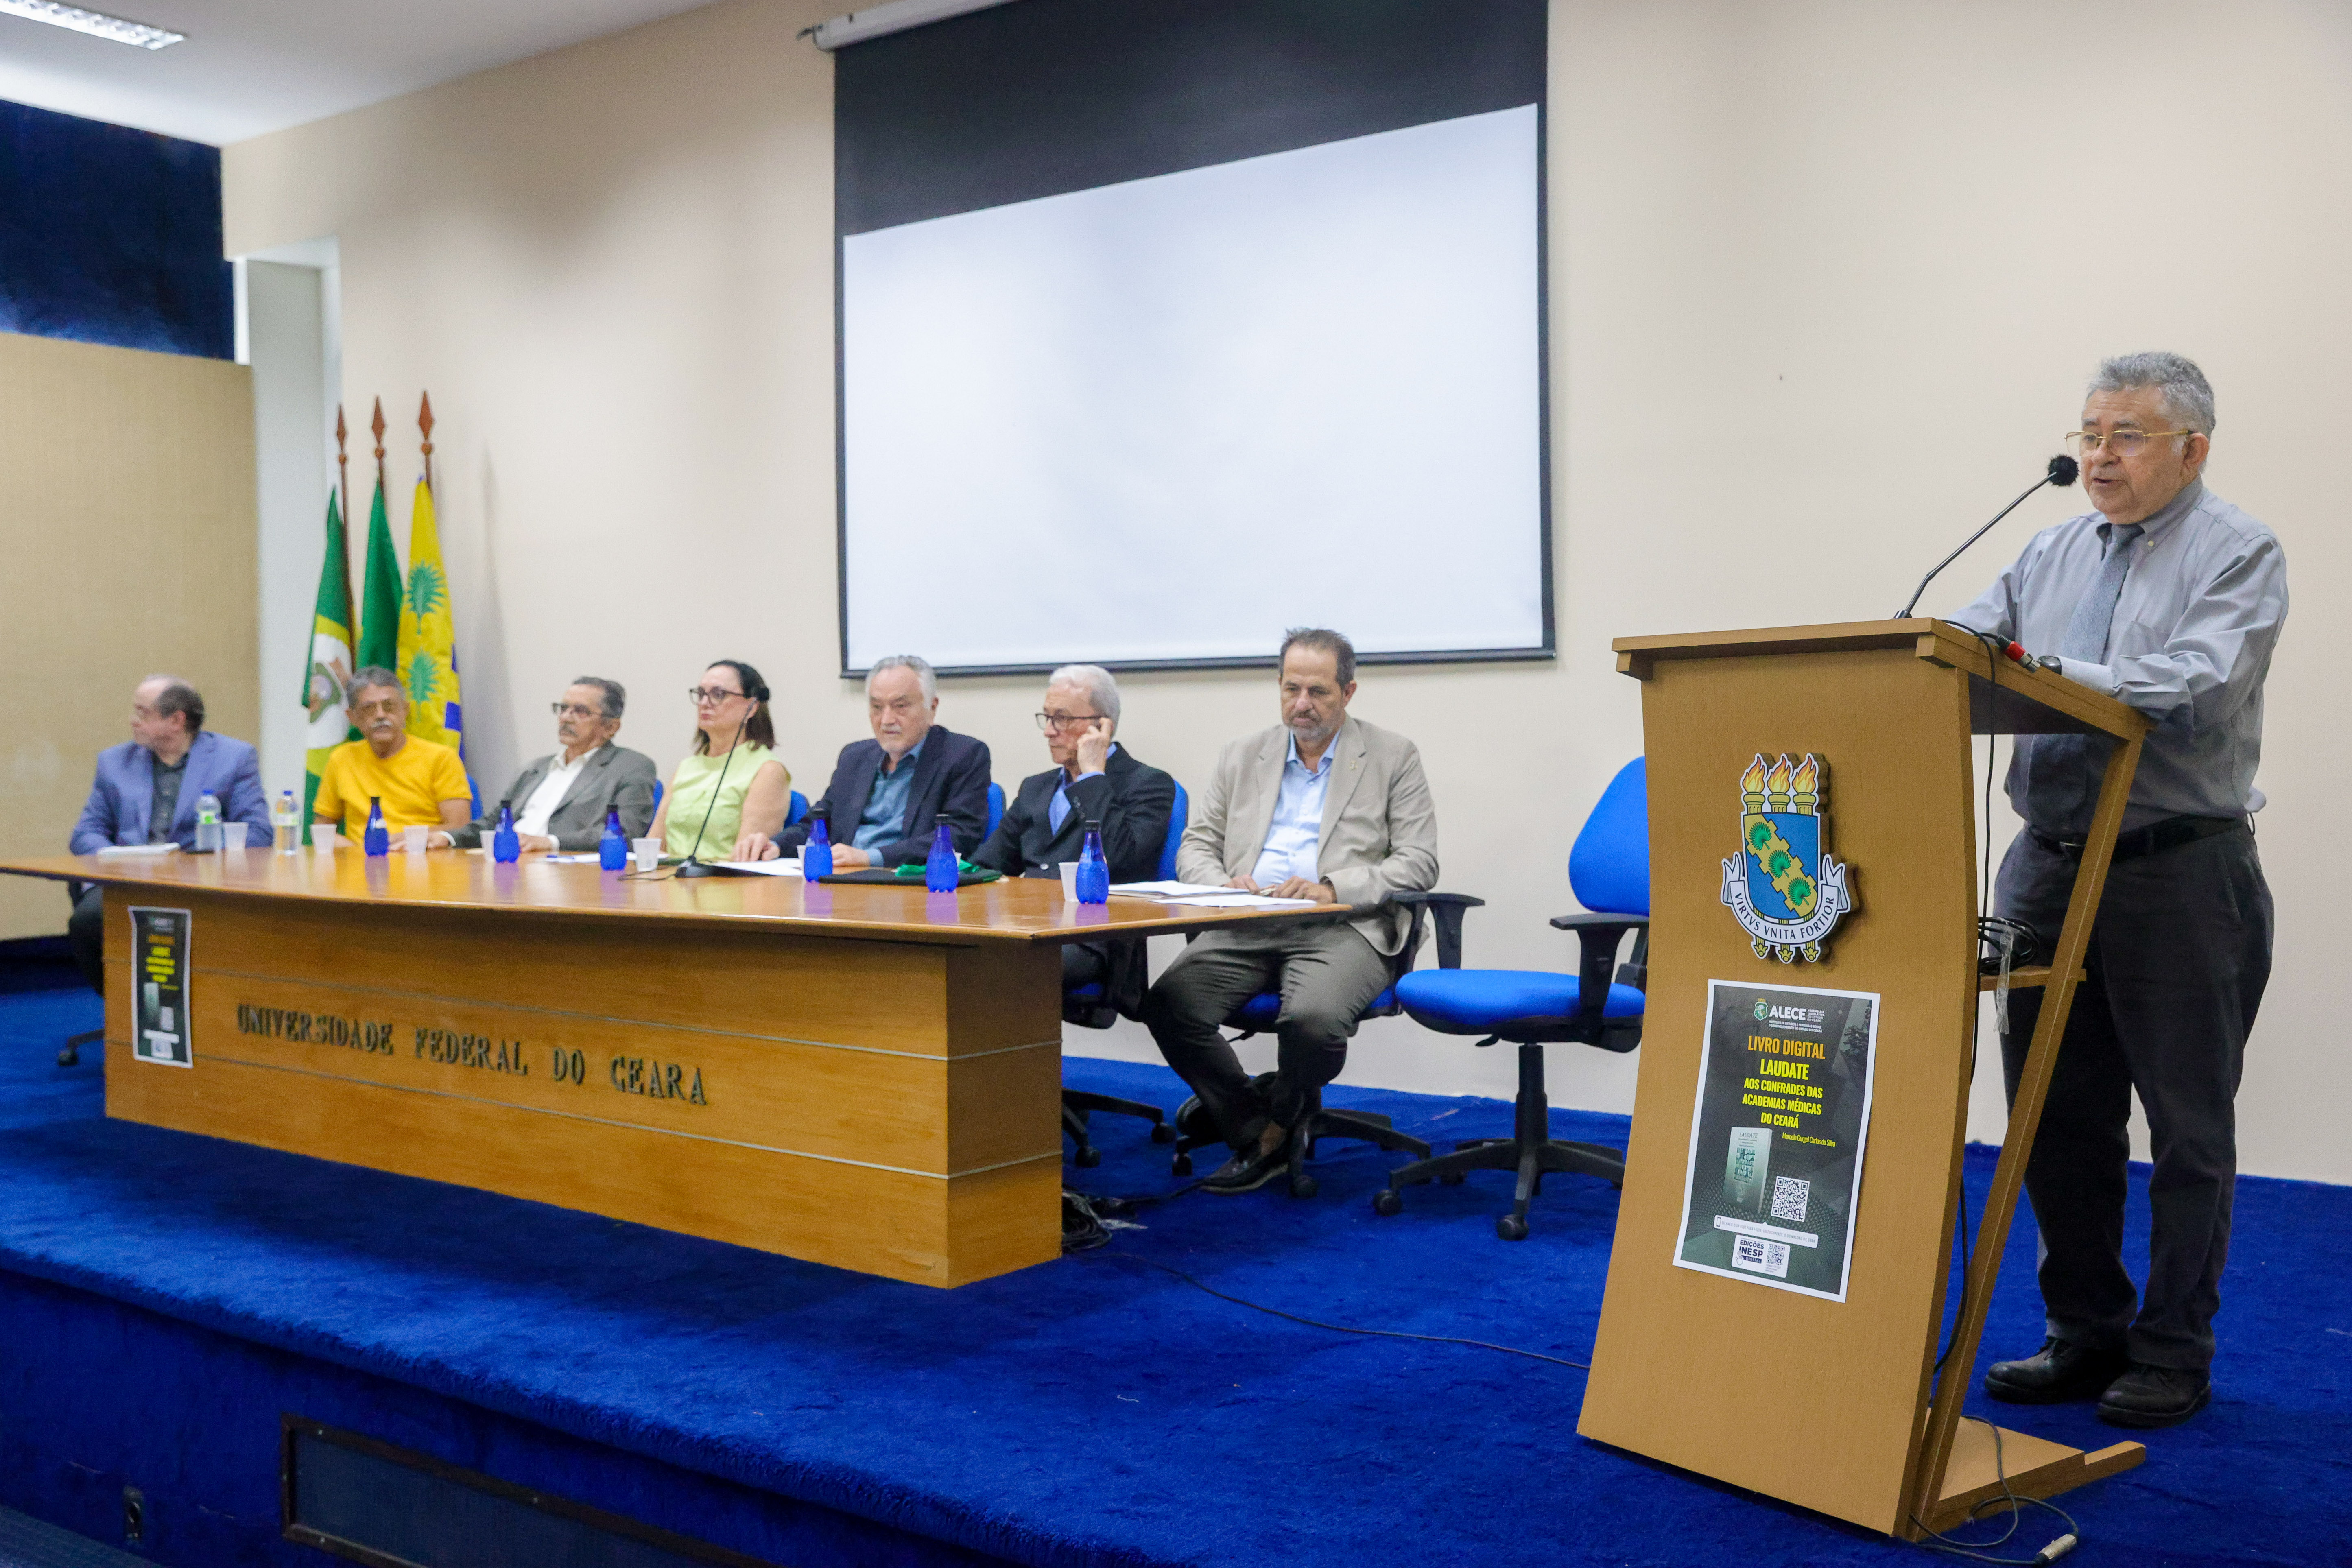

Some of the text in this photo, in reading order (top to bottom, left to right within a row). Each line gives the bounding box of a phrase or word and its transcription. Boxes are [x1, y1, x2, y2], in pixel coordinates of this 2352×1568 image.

[1735, 892, 1834, 939] VIRTVS VNITA FORTIOR
[1769, 1005, 1806, 1021] ALECE
[236, 1003, 708, 1106] UNIVERSIDADE FEDERAL DO CEARA
[1748, 1035, 1826, 1059] LIVRO DIGITAL
[1760, 1058, 1809, 1080] LAUDATE
[1744, 1078, 1823, 1098] AOS CONFRADES DAS
[1742, 1093, 1822, 1115] ACADEMIAS MÉDICAS
[1760, 1112, 1799, 1129] DO CEARÁ
[1782, 1132, 1797, 1141] Marcelo
[1797, 1134, 1810, 1144] Gurgel
[1809, 1136, 1821, 1145] Carlos
[1826, 1139, 1836, 1147] Silva
[1739, 1246, 1763, 1257] INESP
[1740, 1240, 1765, 1249] EDIÇÕES
